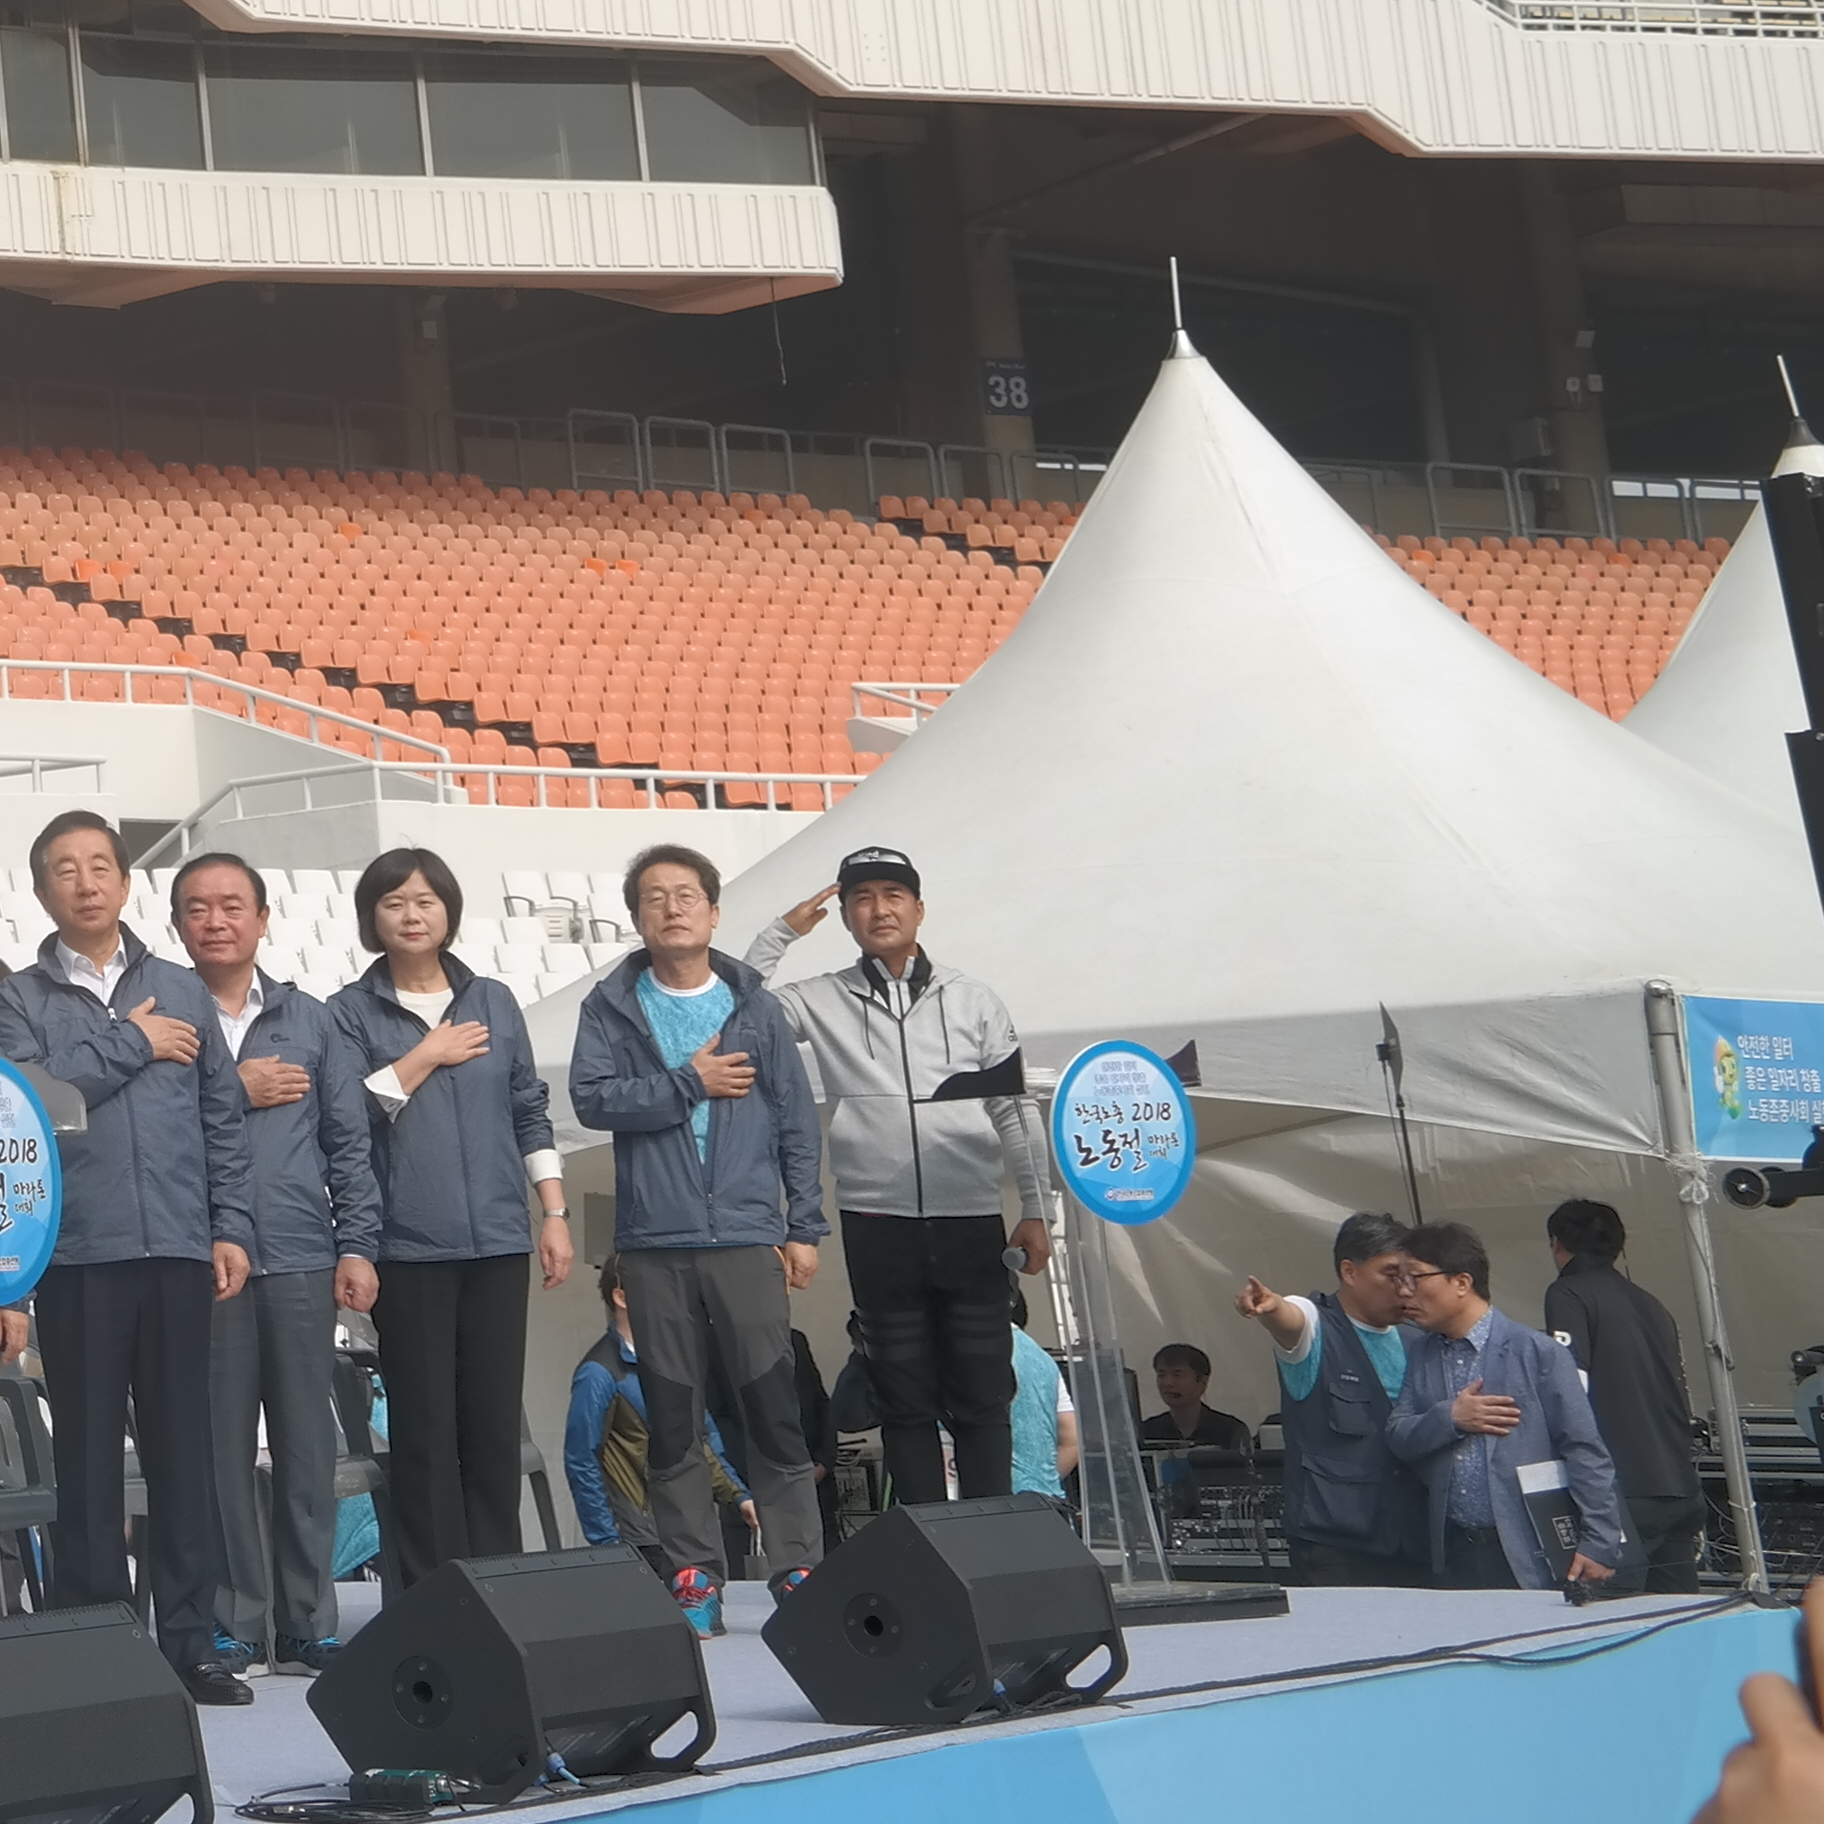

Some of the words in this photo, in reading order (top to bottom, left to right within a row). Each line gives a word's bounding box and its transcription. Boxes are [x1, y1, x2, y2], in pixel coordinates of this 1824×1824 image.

[988, 375, 1030, 409] 38
[1737, 1034, 1771, 1060] 안전한
[1772, 1036, 1795, 1061] 일터
[1745, 1066, 1767, 1091] 좋은
[1767, 1067, 1800, 1092] 일자리
[1800, 1068, 1822, 1093] 창출
[1074, 1101, 1125, 1125] 한국노총
[1131, 1102, 1171, 1122] 2018
[1748, 1098, 1810, 1124] 노동존중사회
[1073, 1127, 1148, 1172] 노동절
[12, 1179, 47, 1203] 마라톤
